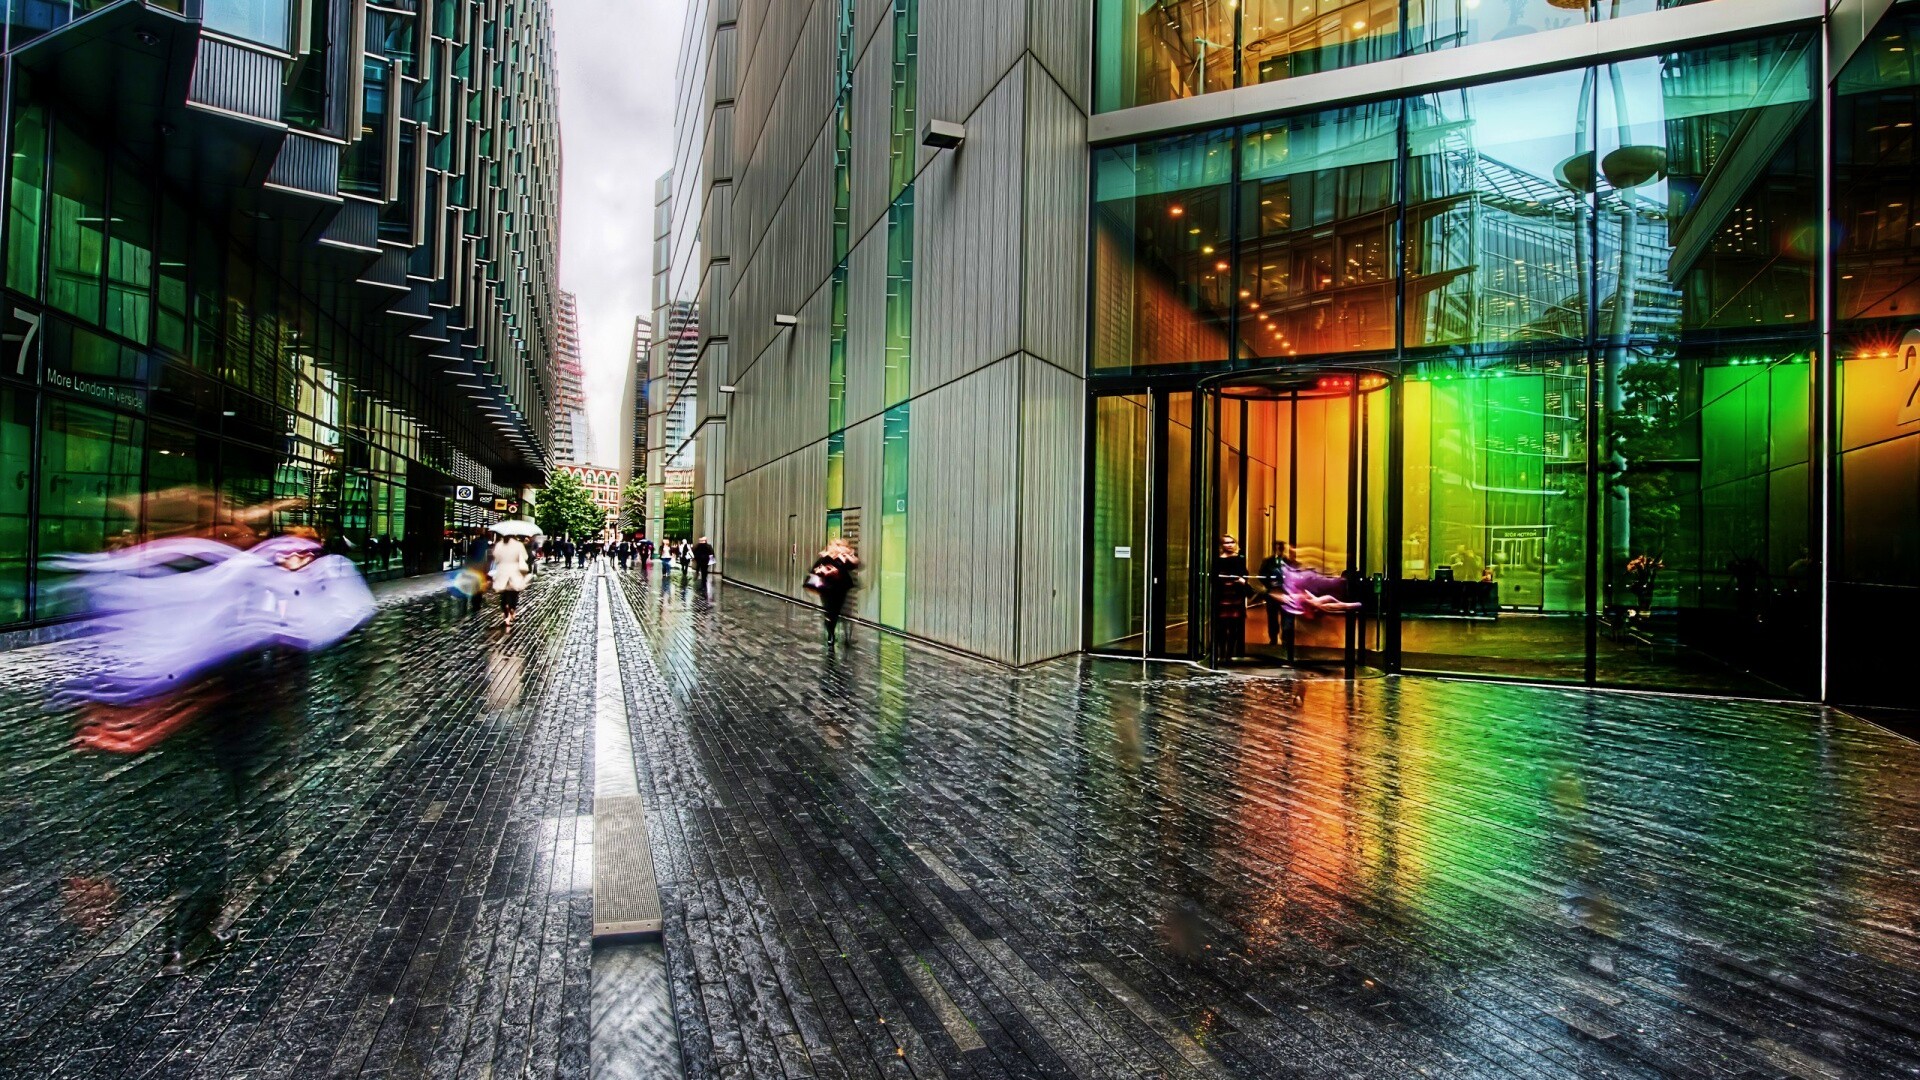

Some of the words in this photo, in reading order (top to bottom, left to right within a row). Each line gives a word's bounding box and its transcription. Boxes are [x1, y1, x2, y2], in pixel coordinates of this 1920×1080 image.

[13, 307, 40, 375] 7
[47, 368, 71, 388] More
[74, 376, 106, 398] London
[108, 387, 143, 408] Riverside
